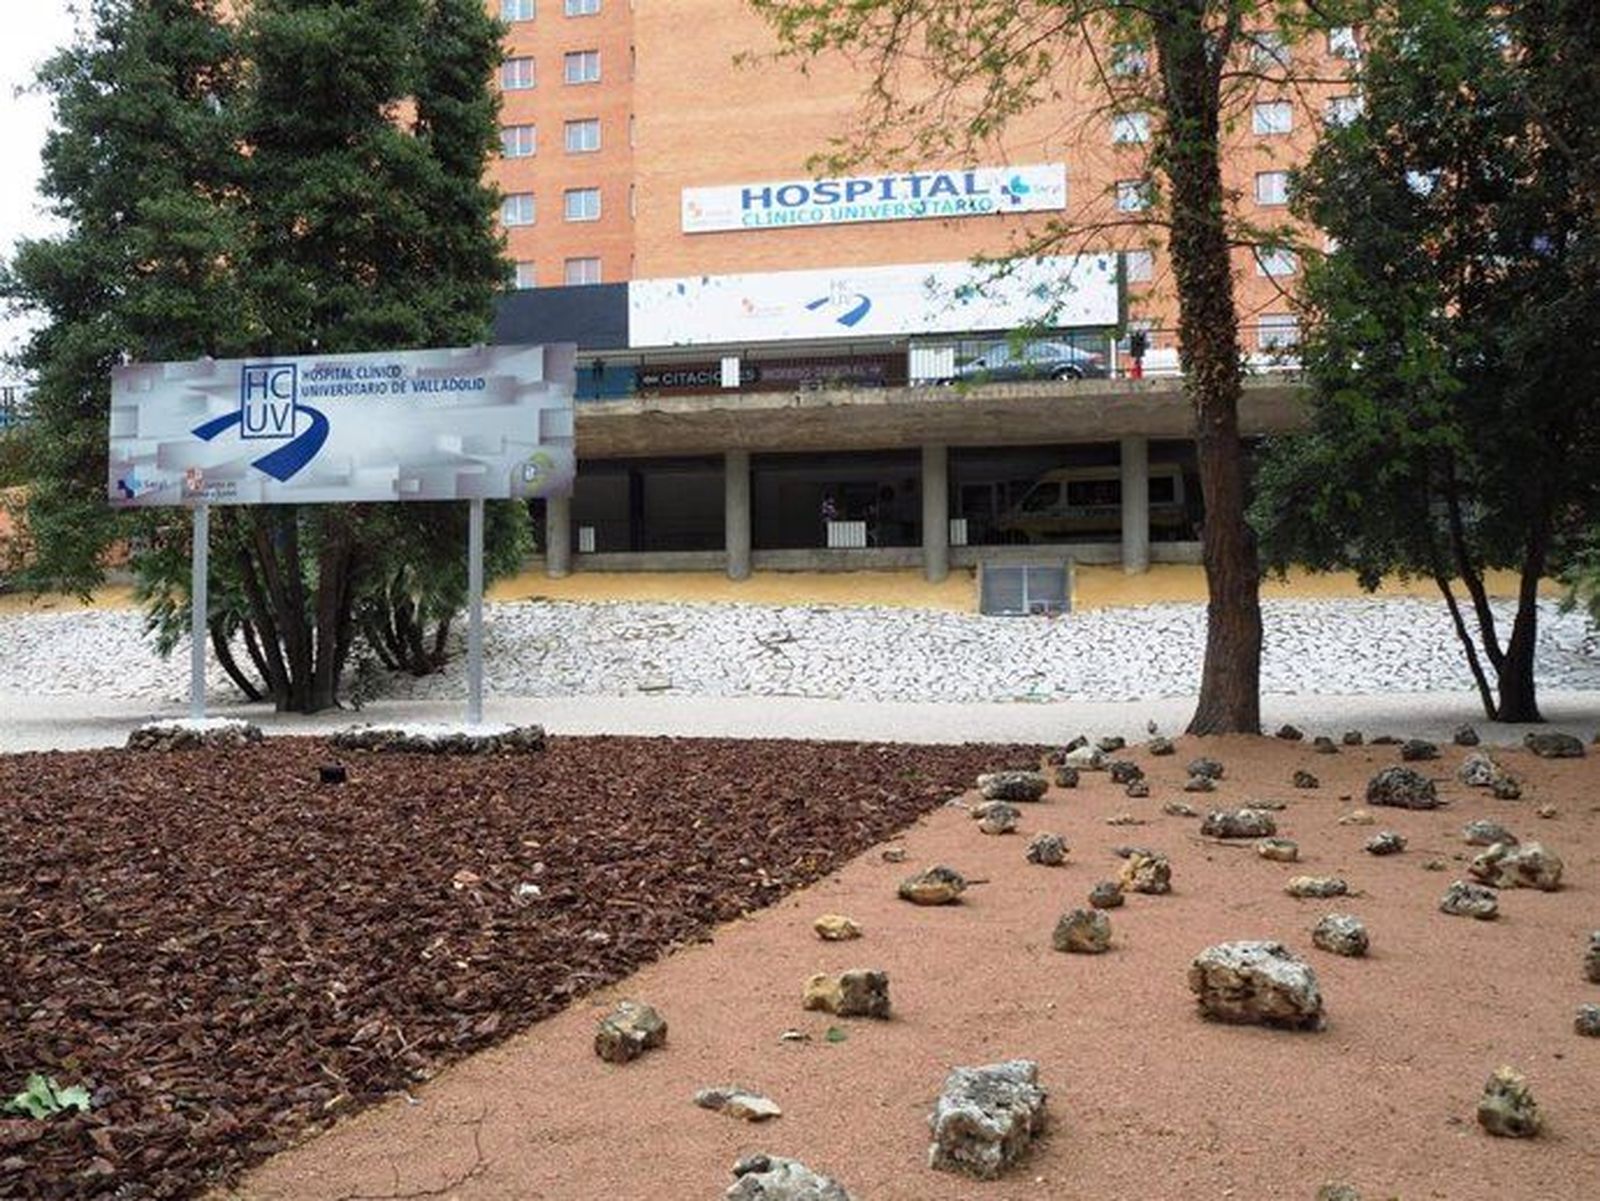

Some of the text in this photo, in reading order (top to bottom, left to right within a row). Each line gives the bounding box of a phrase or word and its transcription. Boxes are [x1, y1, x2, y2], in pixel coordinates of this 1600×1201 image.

[741, 173, 990, 210] HOSPITAL
[831, 198, 992, 220] UNIVERSITARIO
[247, 370, 291, 400] HC
[302, 367, 353, 380] HOSPITAL
[302, 377, 486, 397] UNIVERSITARIO DE VALLADOLID
[247, 403, 291, 432] UV
